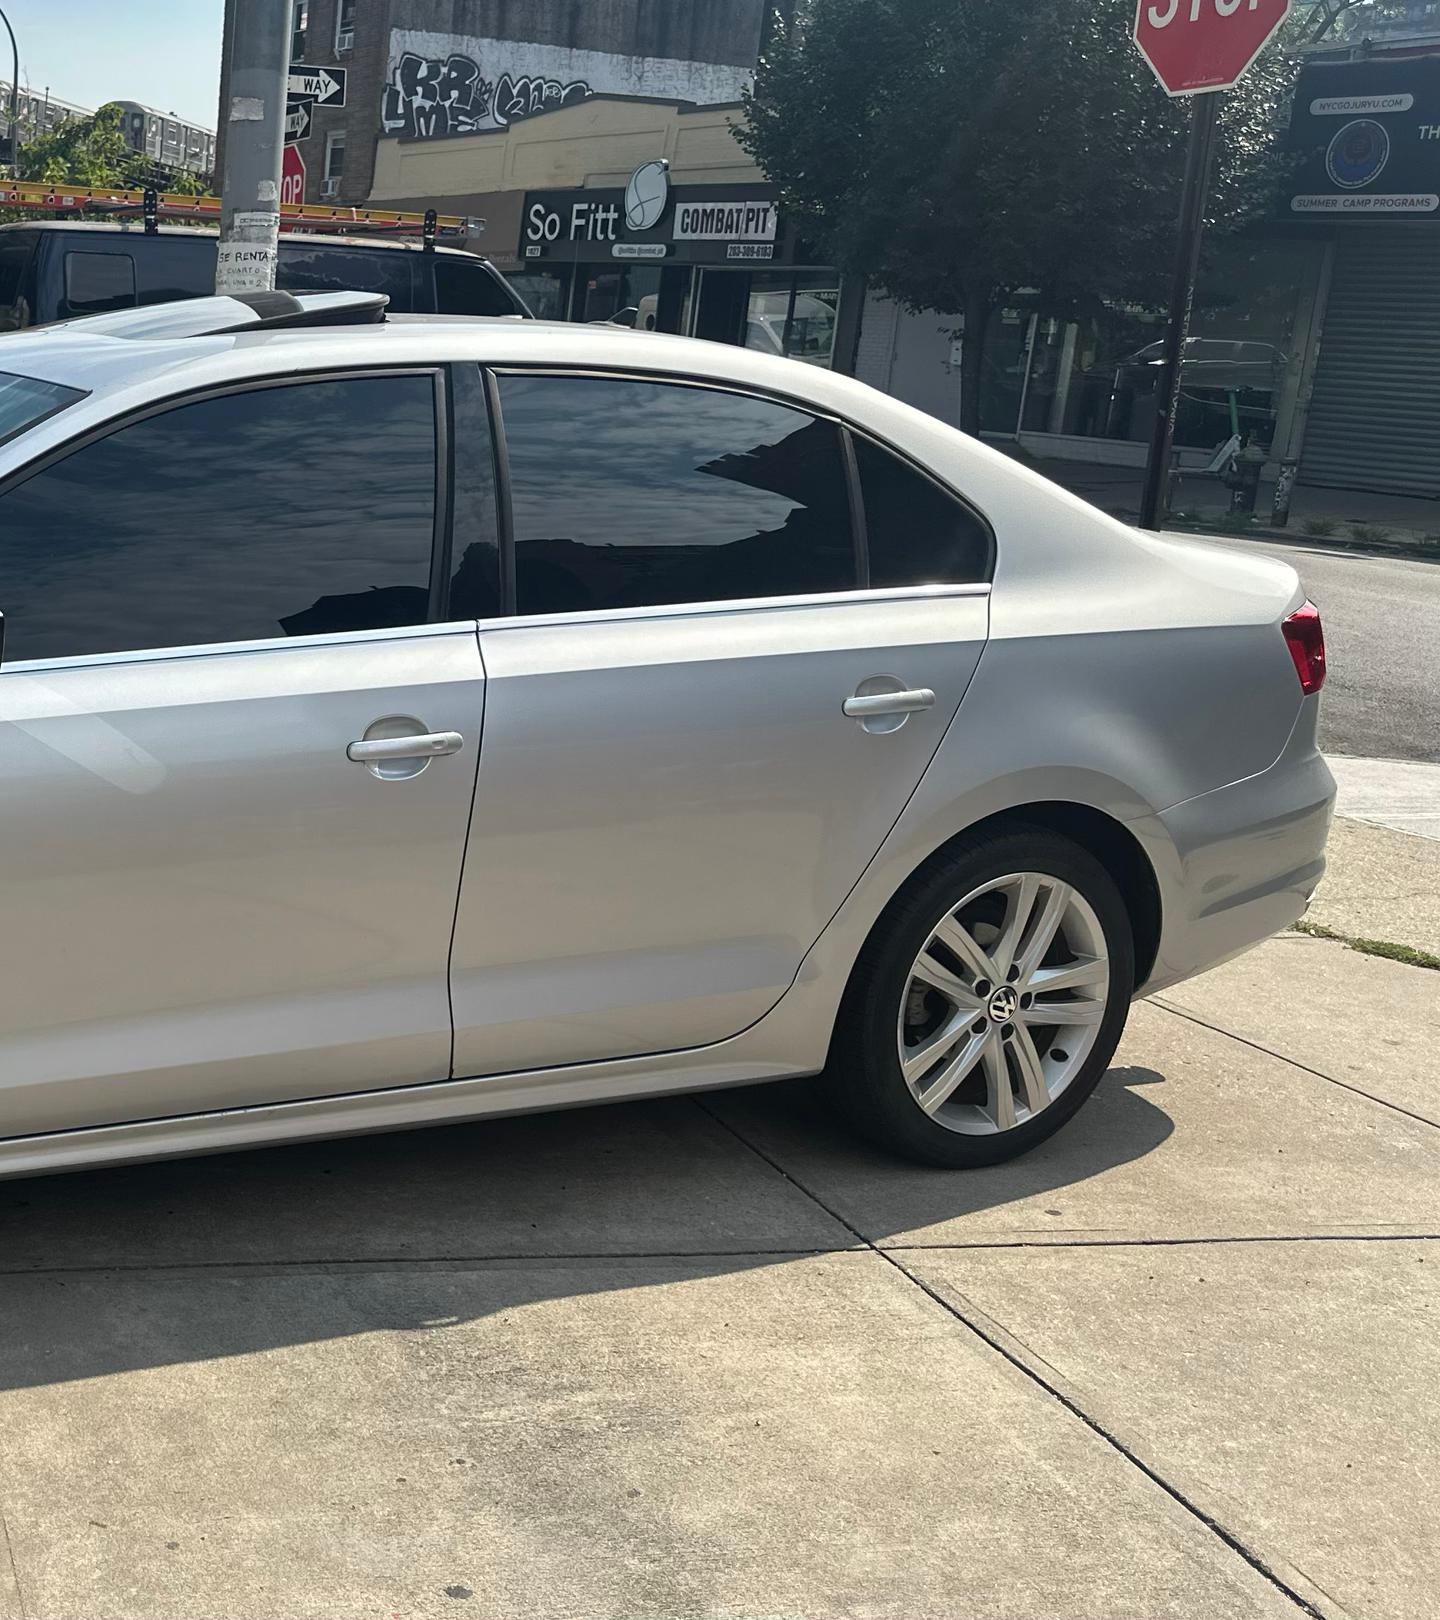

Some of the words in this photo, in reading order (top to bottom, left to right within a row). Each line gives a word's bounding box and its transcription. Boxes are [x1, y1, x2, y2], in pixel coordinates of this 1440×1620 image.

[303, 77, 331, 94] WAY
[1319, 99, 1403, 110] NYCGOJURYU.COM
[290, 112, 306, 129] WAY
[282, 174, 303, 205] OP
[1296, 199, 1337, 209] SUMMER
[1342, 199, 1370, 208] CAMP
[1372, 198, 1431, 209] PROGRAMS
[526, 203, 561, 241] So
[569, 202, 619, 241] Fitt
[680, 207, 743, 234] COMBAT
[744, 206, 770, 234] PIT
[219, 251, 231, 264] SE
[235, 250, 269, 263] RENTA
[227, 267, 260, 275] CUARTO
